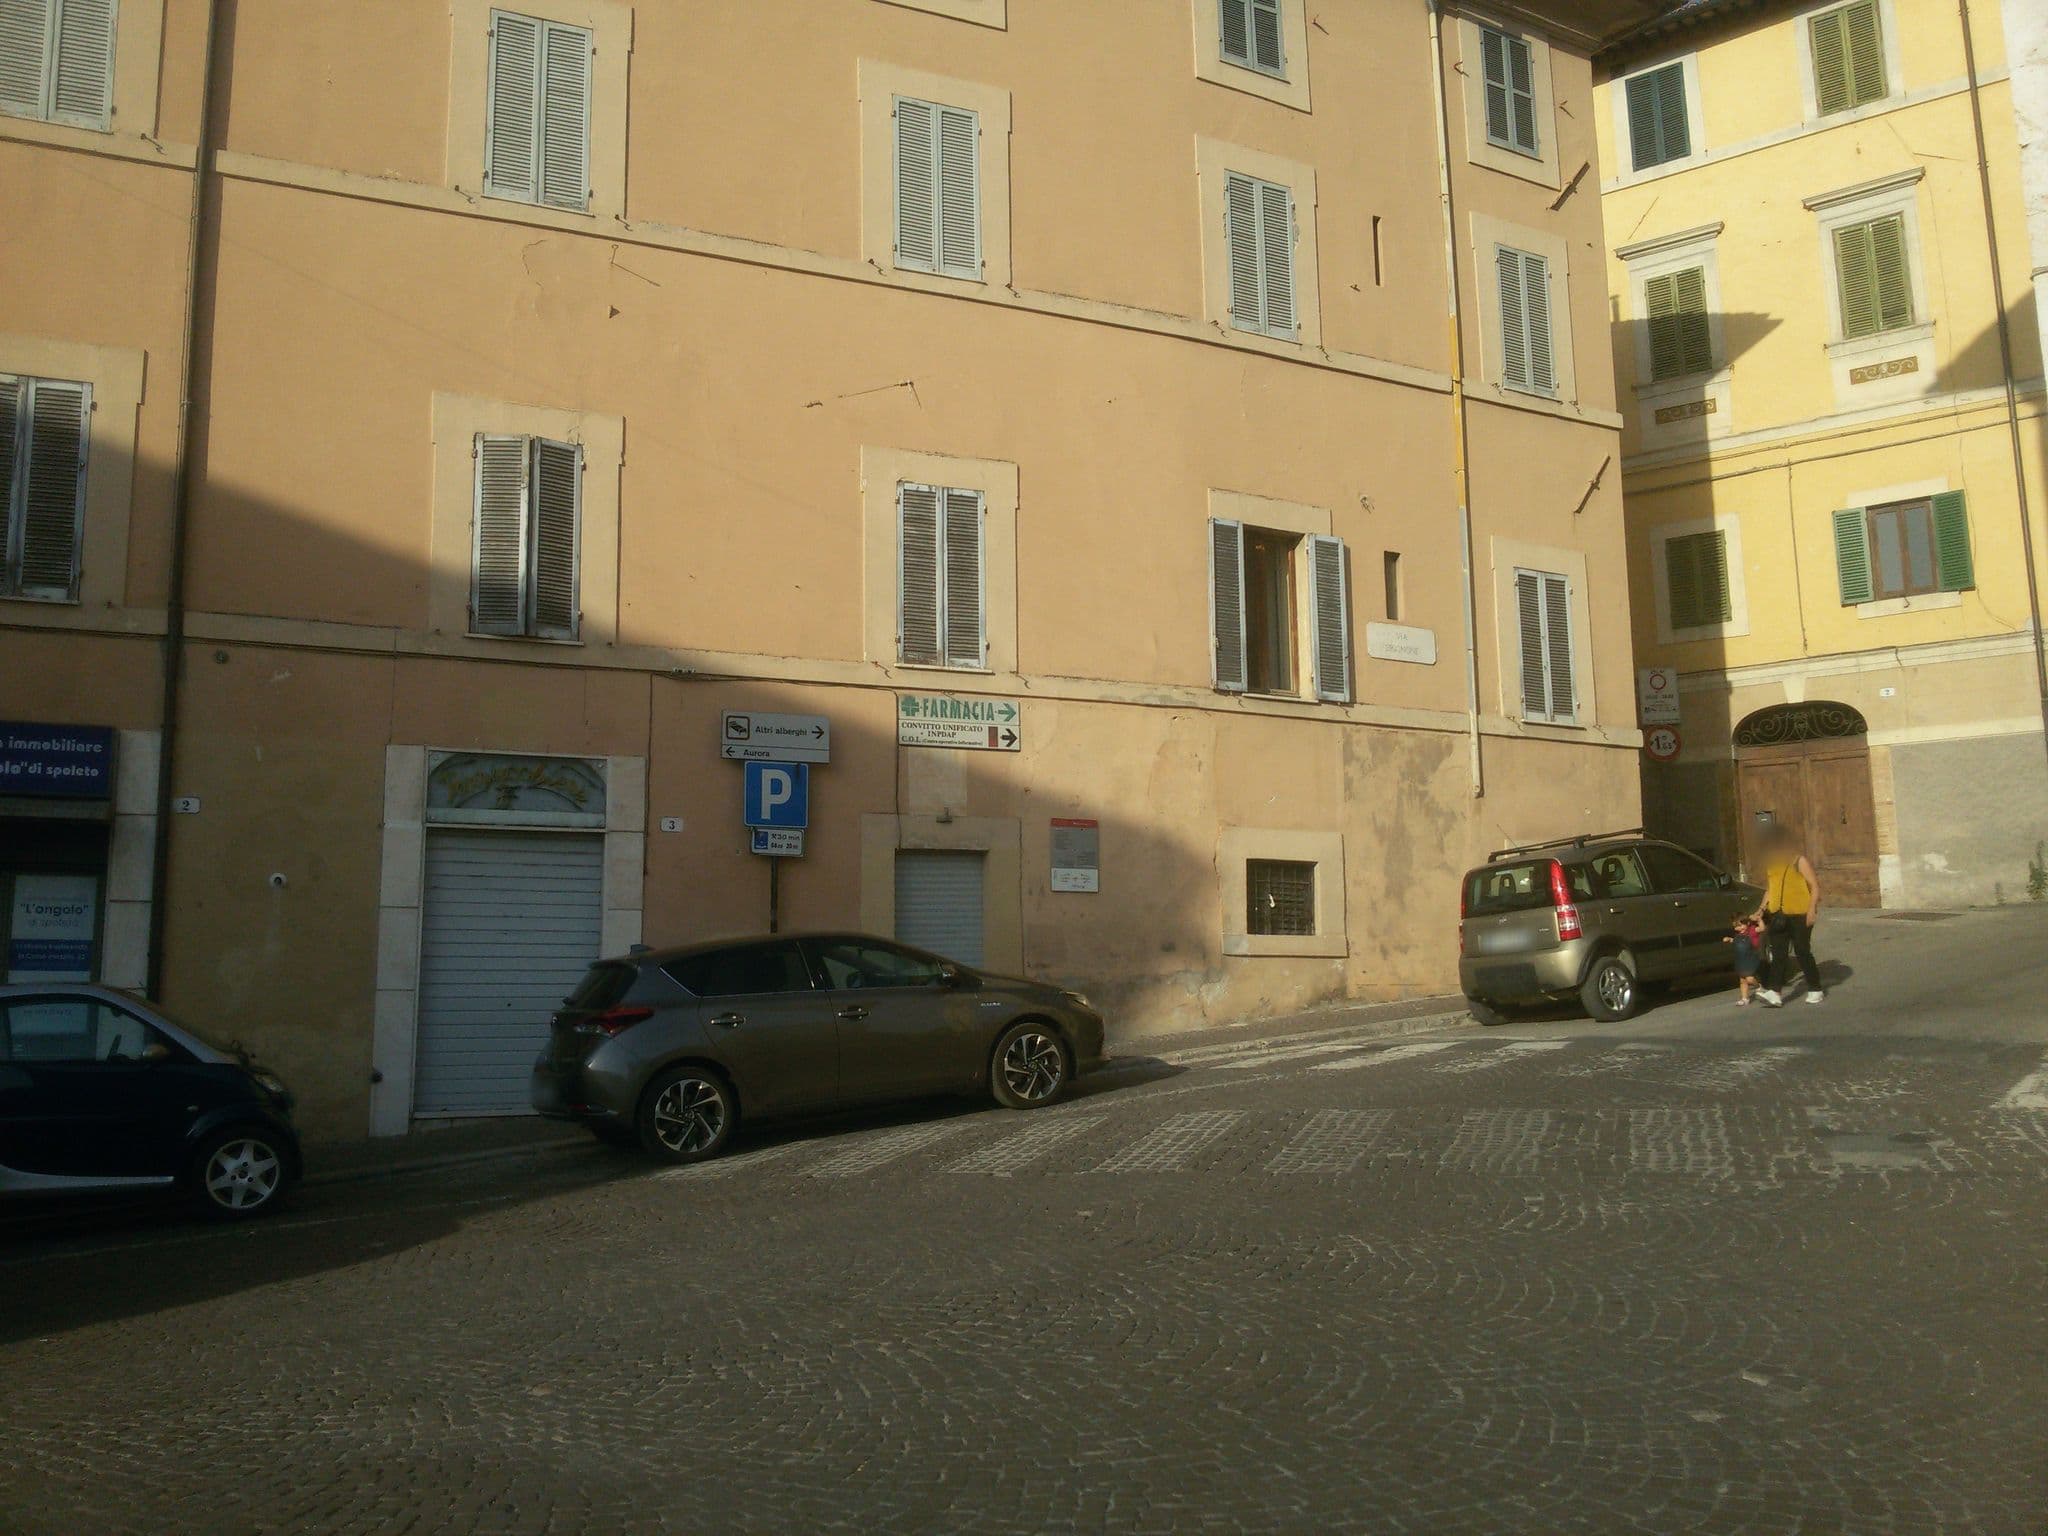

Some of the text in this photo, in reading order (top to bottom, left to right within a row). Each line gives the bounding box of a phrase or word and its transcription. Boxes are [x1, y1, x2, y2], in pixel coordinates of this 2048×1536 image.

[922, 698, 995, 721] FARMACIA
[755, 725, 808, 737] Altri alberghi
[901, 721, 983, 733] CONVITTO UNIFICATO
[8, 735, 103, 753] immobiliare
[743, 749, 770, 757] Aurora
[46, 764, 99, 778] spoleto
[761, 769, 792, 819] P
[182, 800, 190, 811] 2
[668, 820, 675, 830] 3
